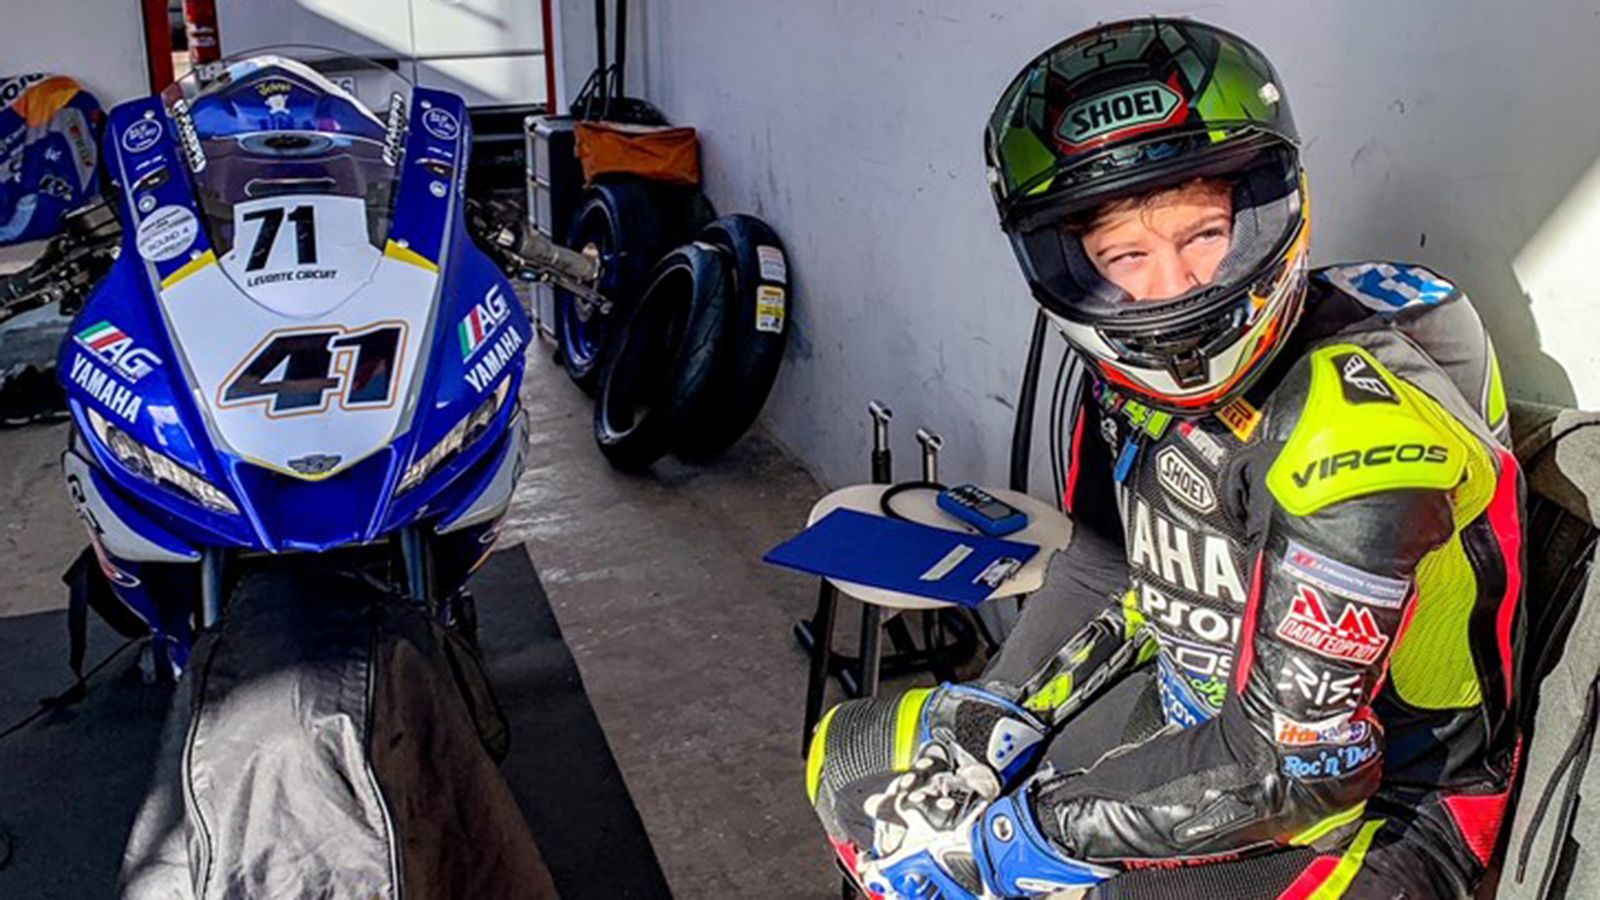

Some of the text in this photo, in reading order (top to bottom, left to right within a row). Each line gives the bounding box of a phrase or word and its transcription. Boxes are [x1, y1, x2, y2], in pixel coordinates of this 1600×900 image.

[1071, 89, 1163, 136] SHOEI
[243, 205, 317, 272] 71
[296, 269, 337, 280] CIRCUIT
[99, 337, 163, 380] AG
[218, 322, 406, 416] 41
[464, 325, 523, 393] YAMAHA
[70, 352, 142, 424] YAMAHA
[1162, 455, 1207, 504] SHOEI
[1291, 443, 1448, 488] VIRCOS
